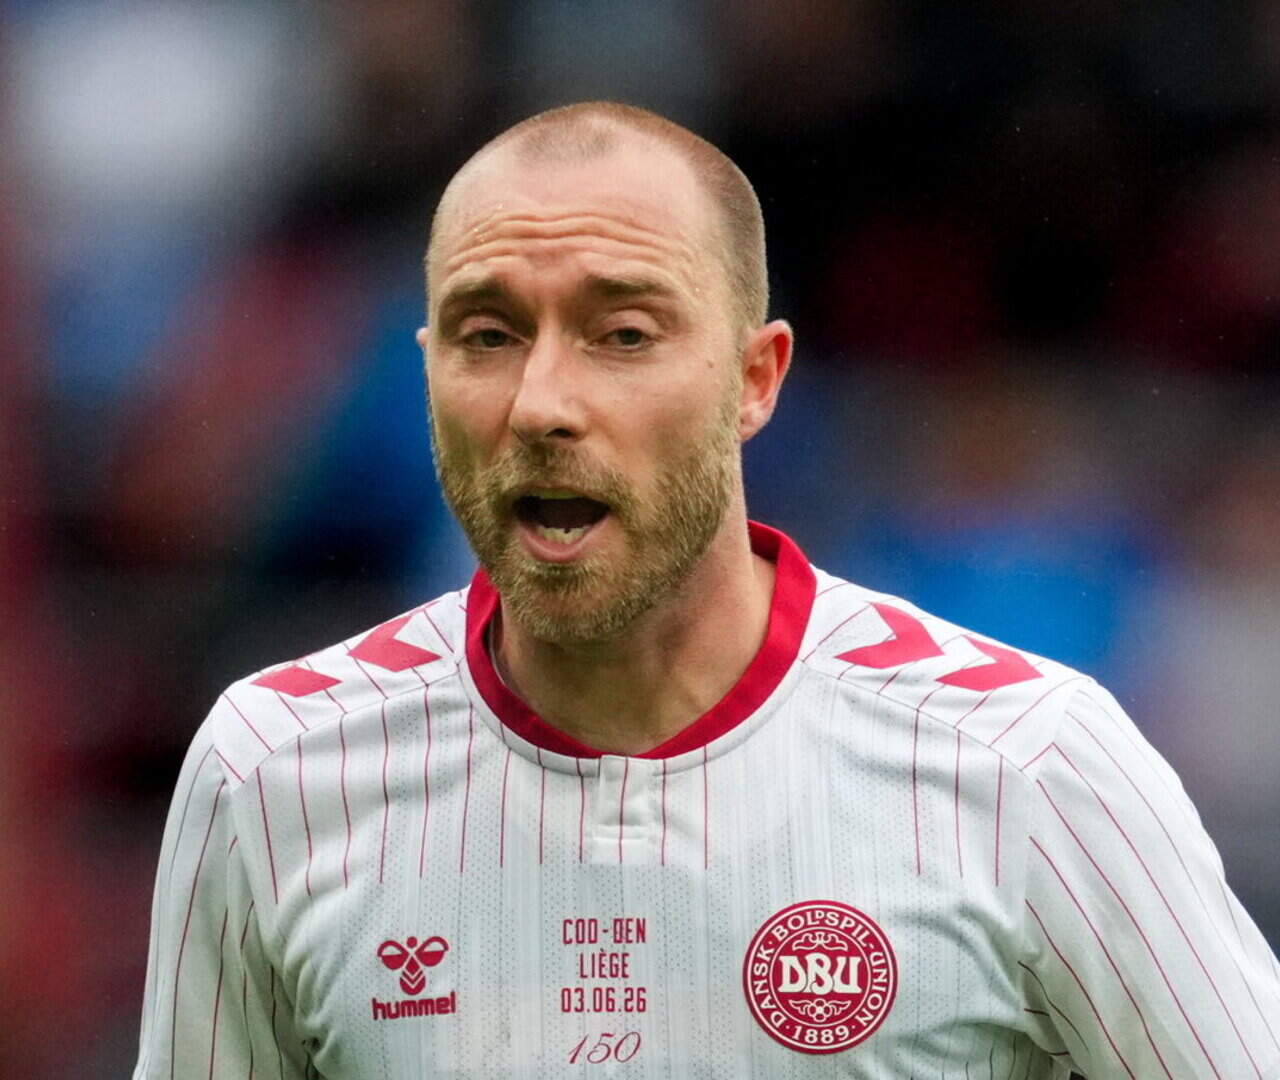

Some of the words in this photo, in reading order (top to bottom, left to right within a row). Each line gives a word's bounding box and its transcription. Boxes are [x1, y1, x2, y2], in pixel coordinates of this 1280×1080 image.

[563, 918, 646, 944] COD-DEN
[580, 948, 629, 978] LIÈGE
[778, 952, 862, 995] DBU
[561, 987, 646, 1012] 03.06.26
[753, 944, 787, 1028] DANSK
[372, 990, 455, 1020] hummel
[568, 1032, 641, 1064] 150
[792, 1025, 849, 1044] 1889
